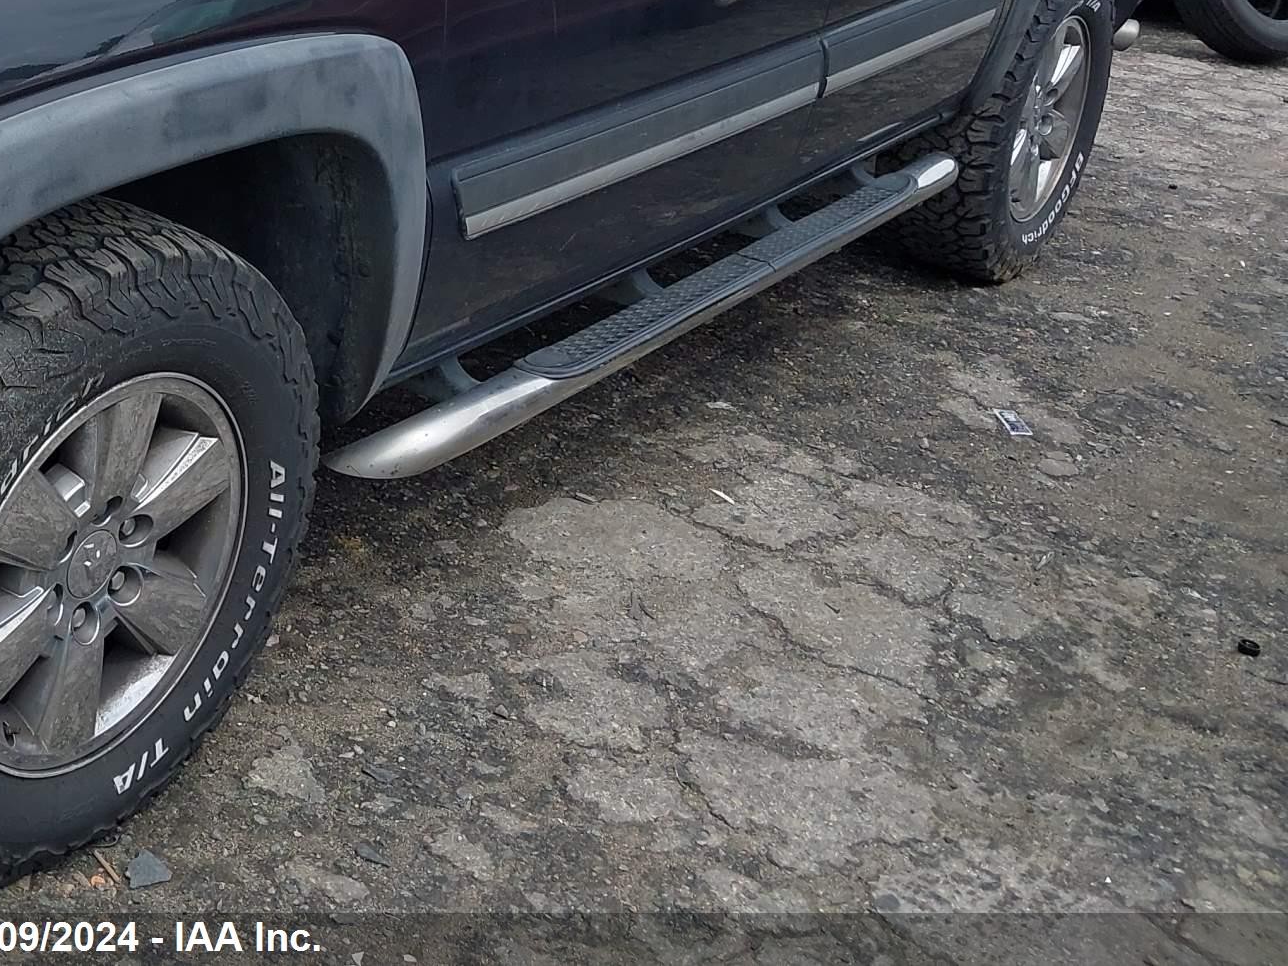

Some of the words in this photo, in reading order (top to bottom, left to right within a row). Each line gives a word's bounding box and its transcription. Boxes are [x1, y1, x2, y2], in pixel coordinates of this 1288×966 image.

[1021, 152, 1085, 245] BFGoodrich
[182, 459, 287, 723] All-Terrain
[112, 736, 171, 796] T/A
